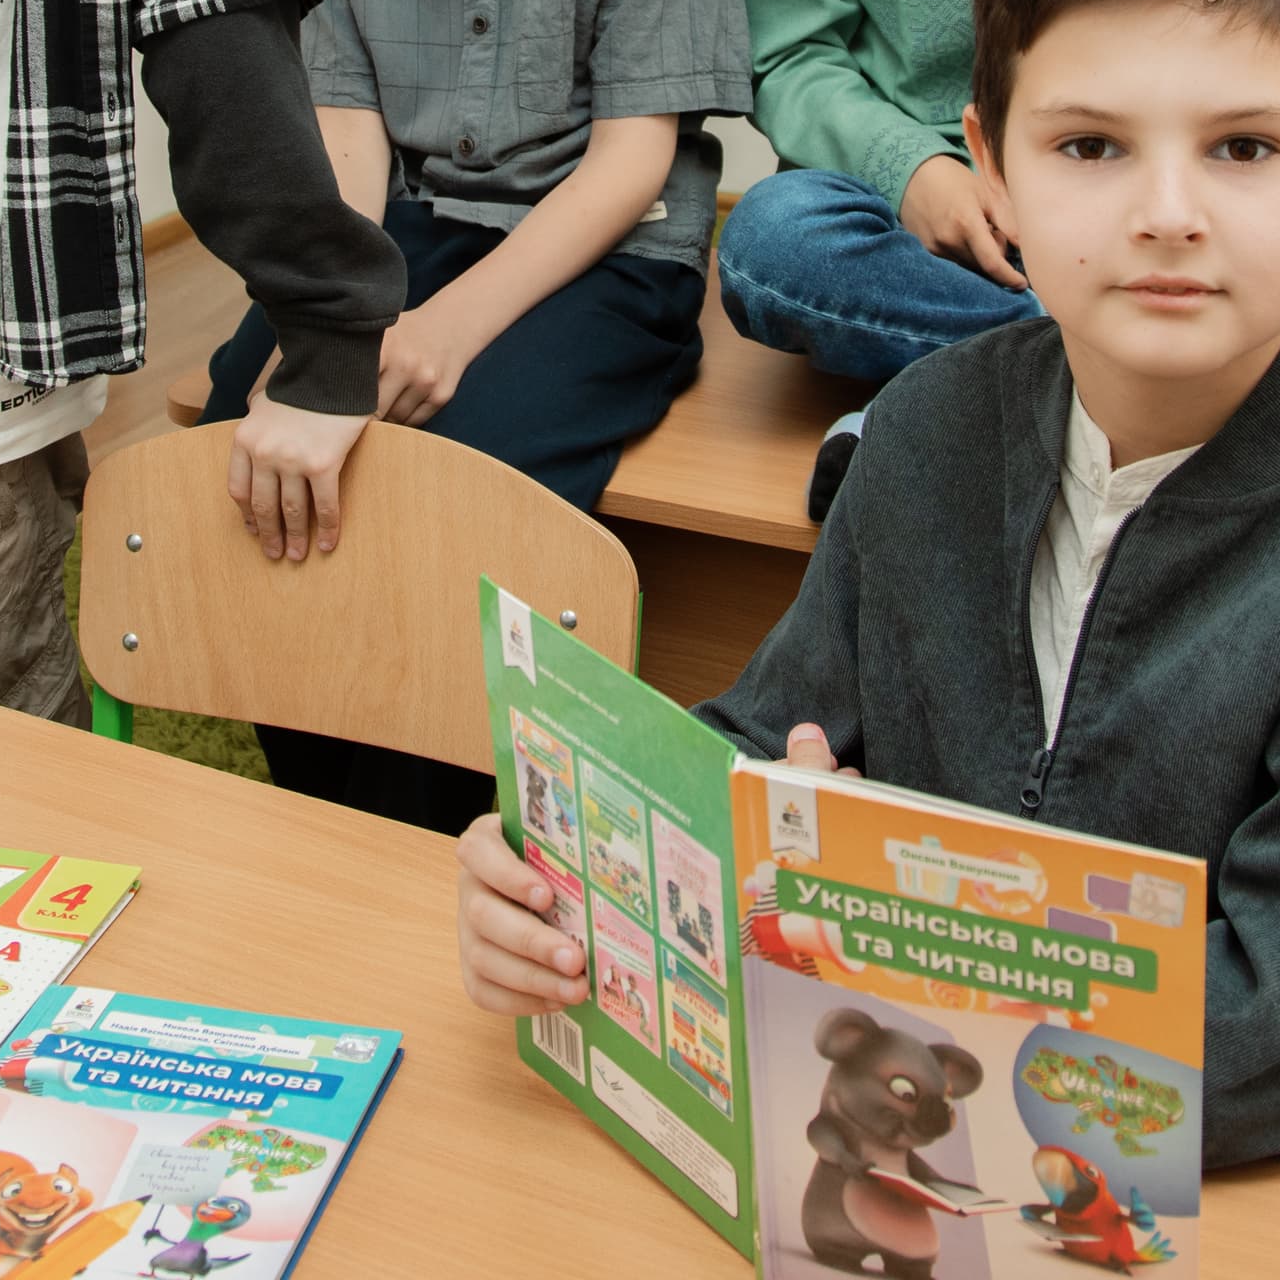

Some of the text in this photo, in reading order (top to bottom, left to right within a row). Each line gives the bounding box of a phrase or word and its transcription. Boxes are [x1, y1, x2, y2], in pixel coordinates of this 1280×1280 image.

[35, 908, 80, 921] КЛАС
[49, 883, 94, 912] 4
[795, 878, 1136, 979] Українська мова
[851, 930, 1075, 1001] та читання
[53, 1037, 323, 1093] Українська мова
[86, 1065, 266, 1106] та читання
